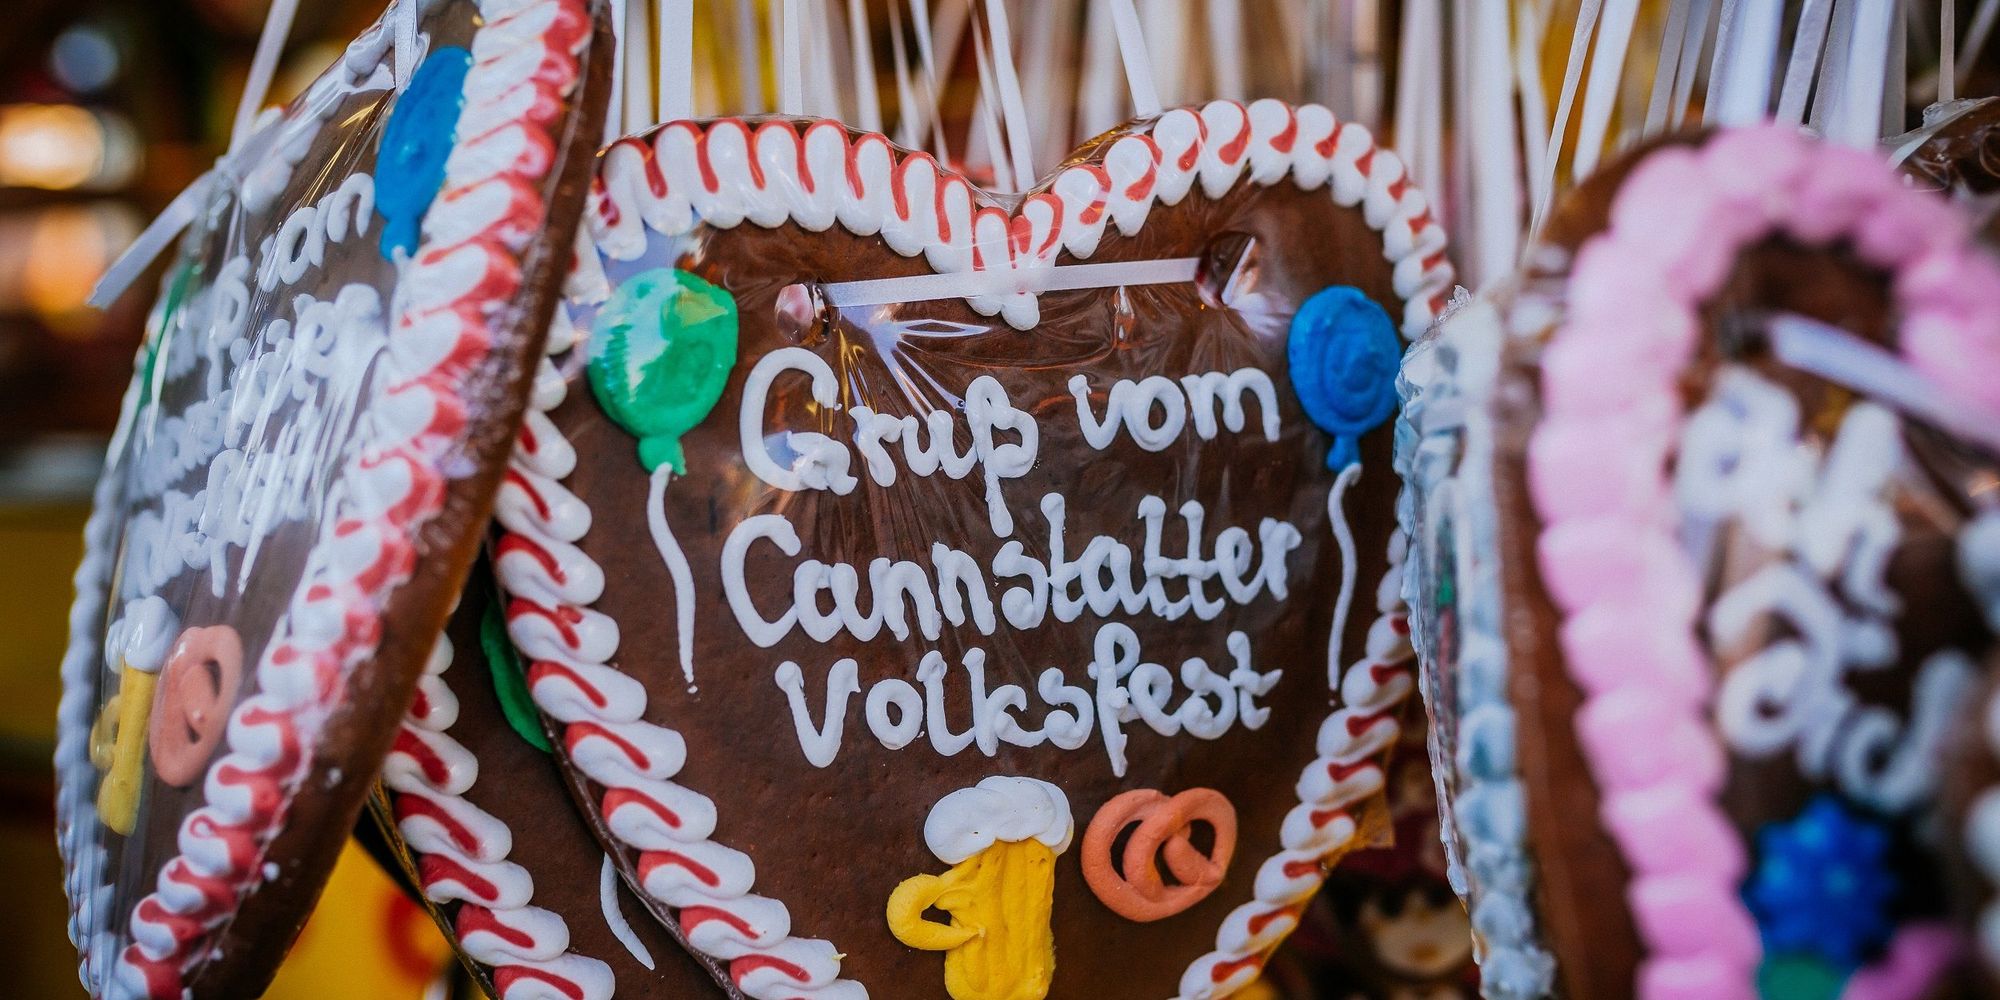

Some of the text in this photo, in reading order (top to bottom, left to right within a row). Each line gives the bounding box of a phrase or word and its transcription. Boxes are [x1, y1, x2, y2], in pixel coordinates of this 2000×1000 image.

[740, 347, 1280, 537] Gruß vom
[721, 492, 1302, 648] Cannstatter
[775, 622, 1283, 777] Volksfest
